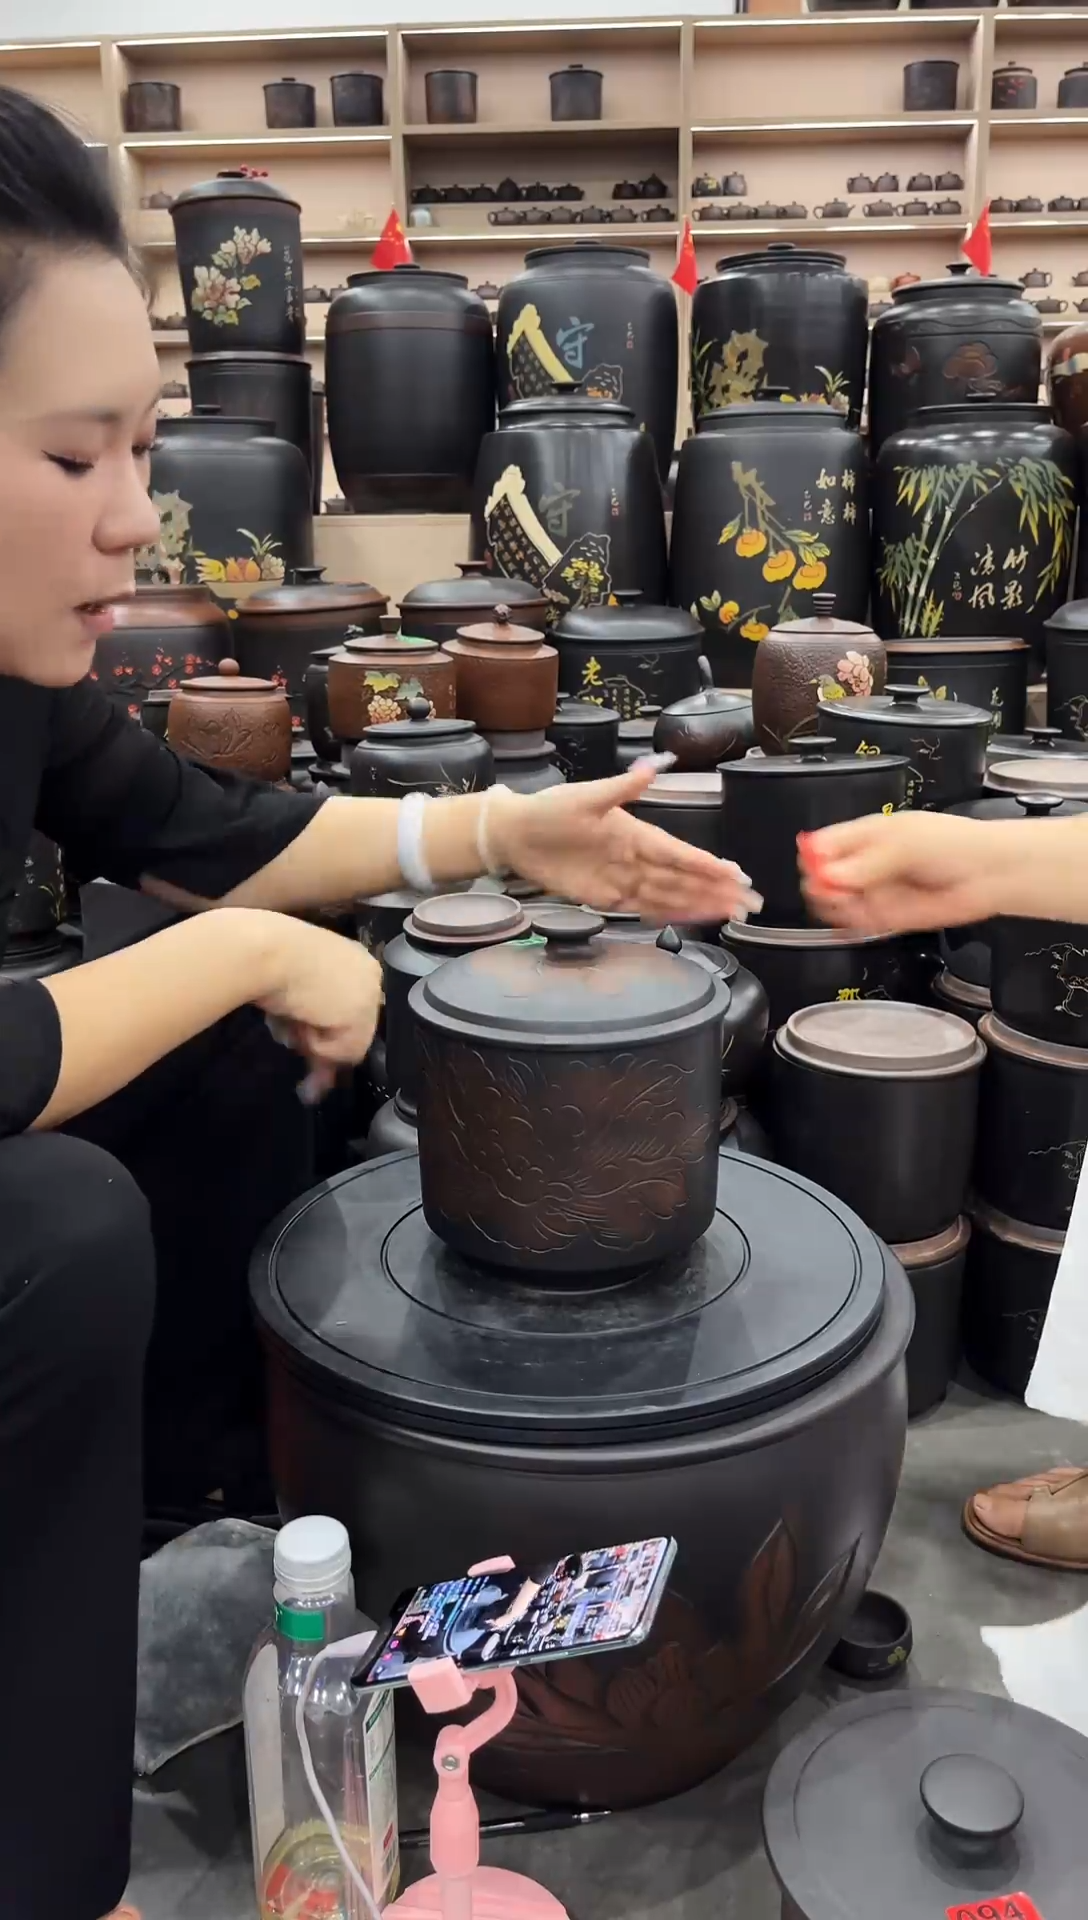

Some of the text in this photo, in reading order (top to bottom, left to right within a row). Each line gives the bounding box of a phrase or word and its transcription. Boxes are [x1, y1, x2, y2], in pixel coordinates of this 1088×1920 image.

[556, 316, 594, 369] 守
[815, 467, 837, 525] 如意
[1000, 545, 1028, 610] 竹影
